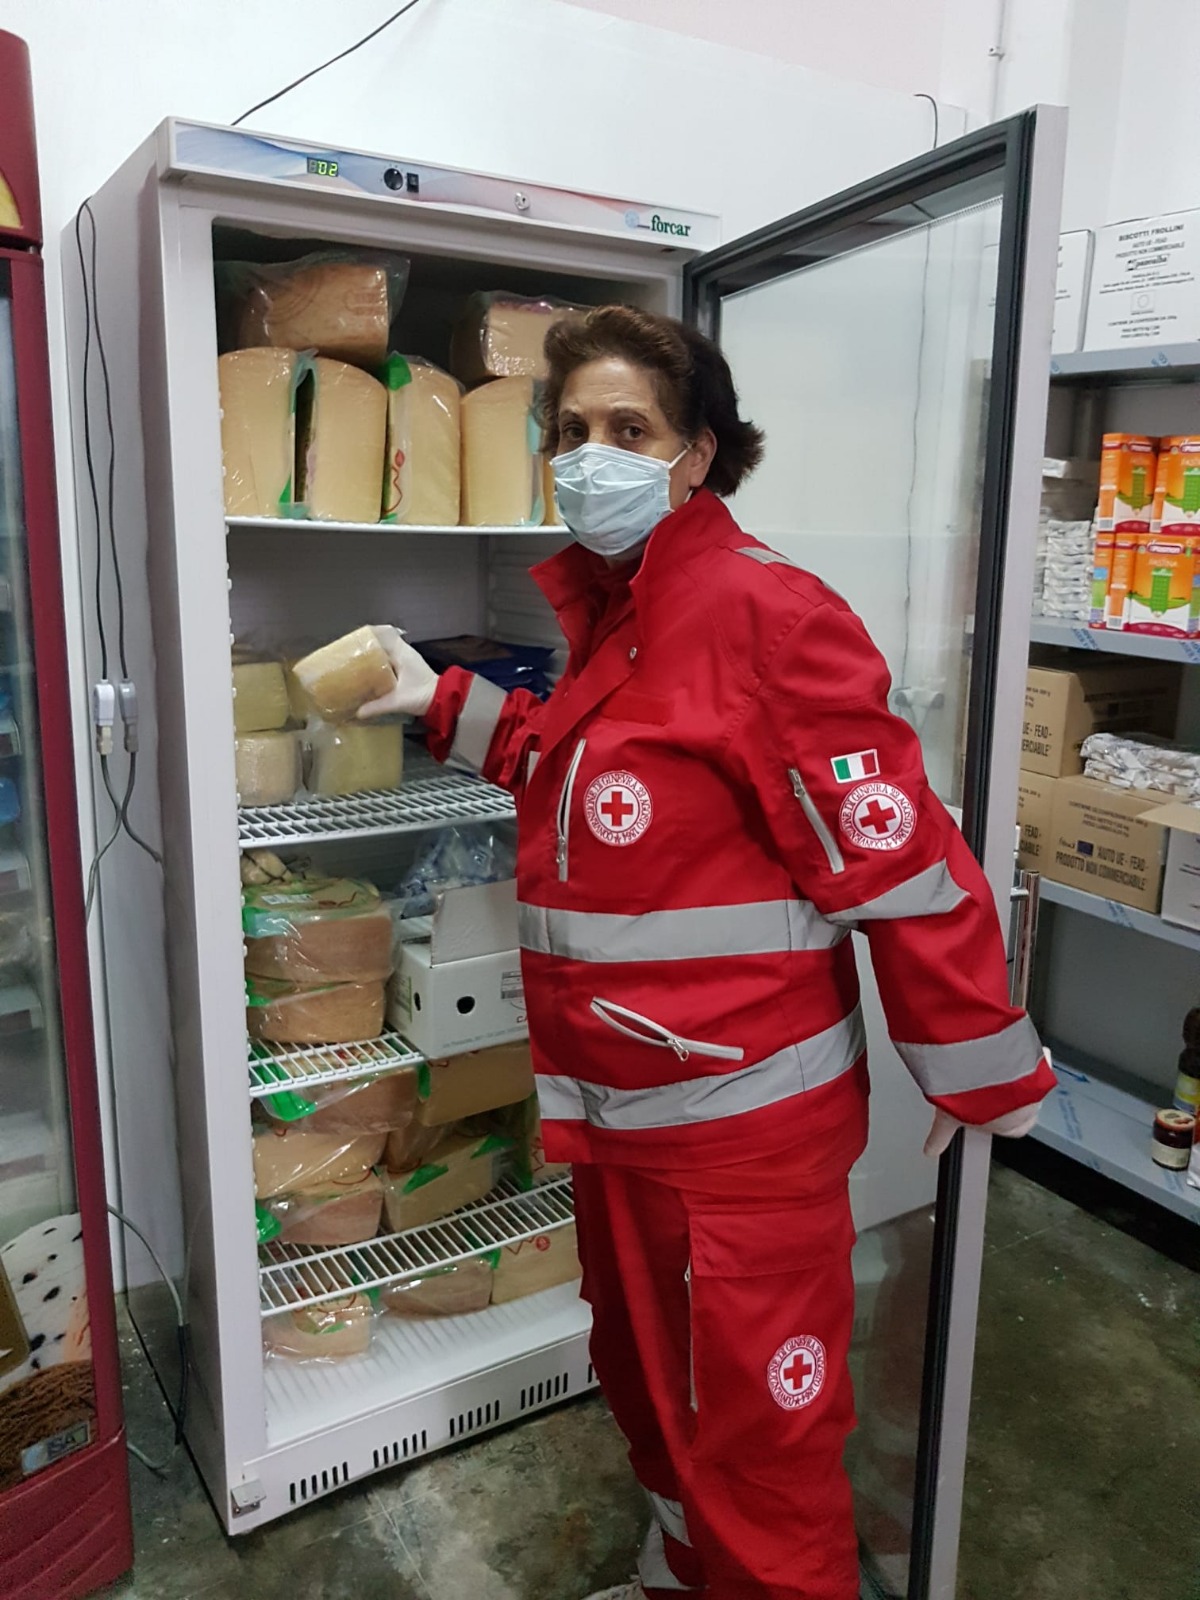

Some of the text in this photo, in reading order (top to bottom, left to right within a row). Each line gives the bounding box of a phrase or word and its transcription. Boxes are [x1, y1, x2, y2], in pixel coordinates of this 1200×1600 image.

[651, 214, 691, 237] forcar
[1119, 224, 1184, 241] BISCOTTI FROLLINI
[601, 773, 637, 790] GINEVRA
[639, 799, 651, 830] AGOSTO
[844, 798, 856, 811] DI
[851, 784, 888, 801] GINEVRA
[897, 797, 912, 828] AGOSTO
